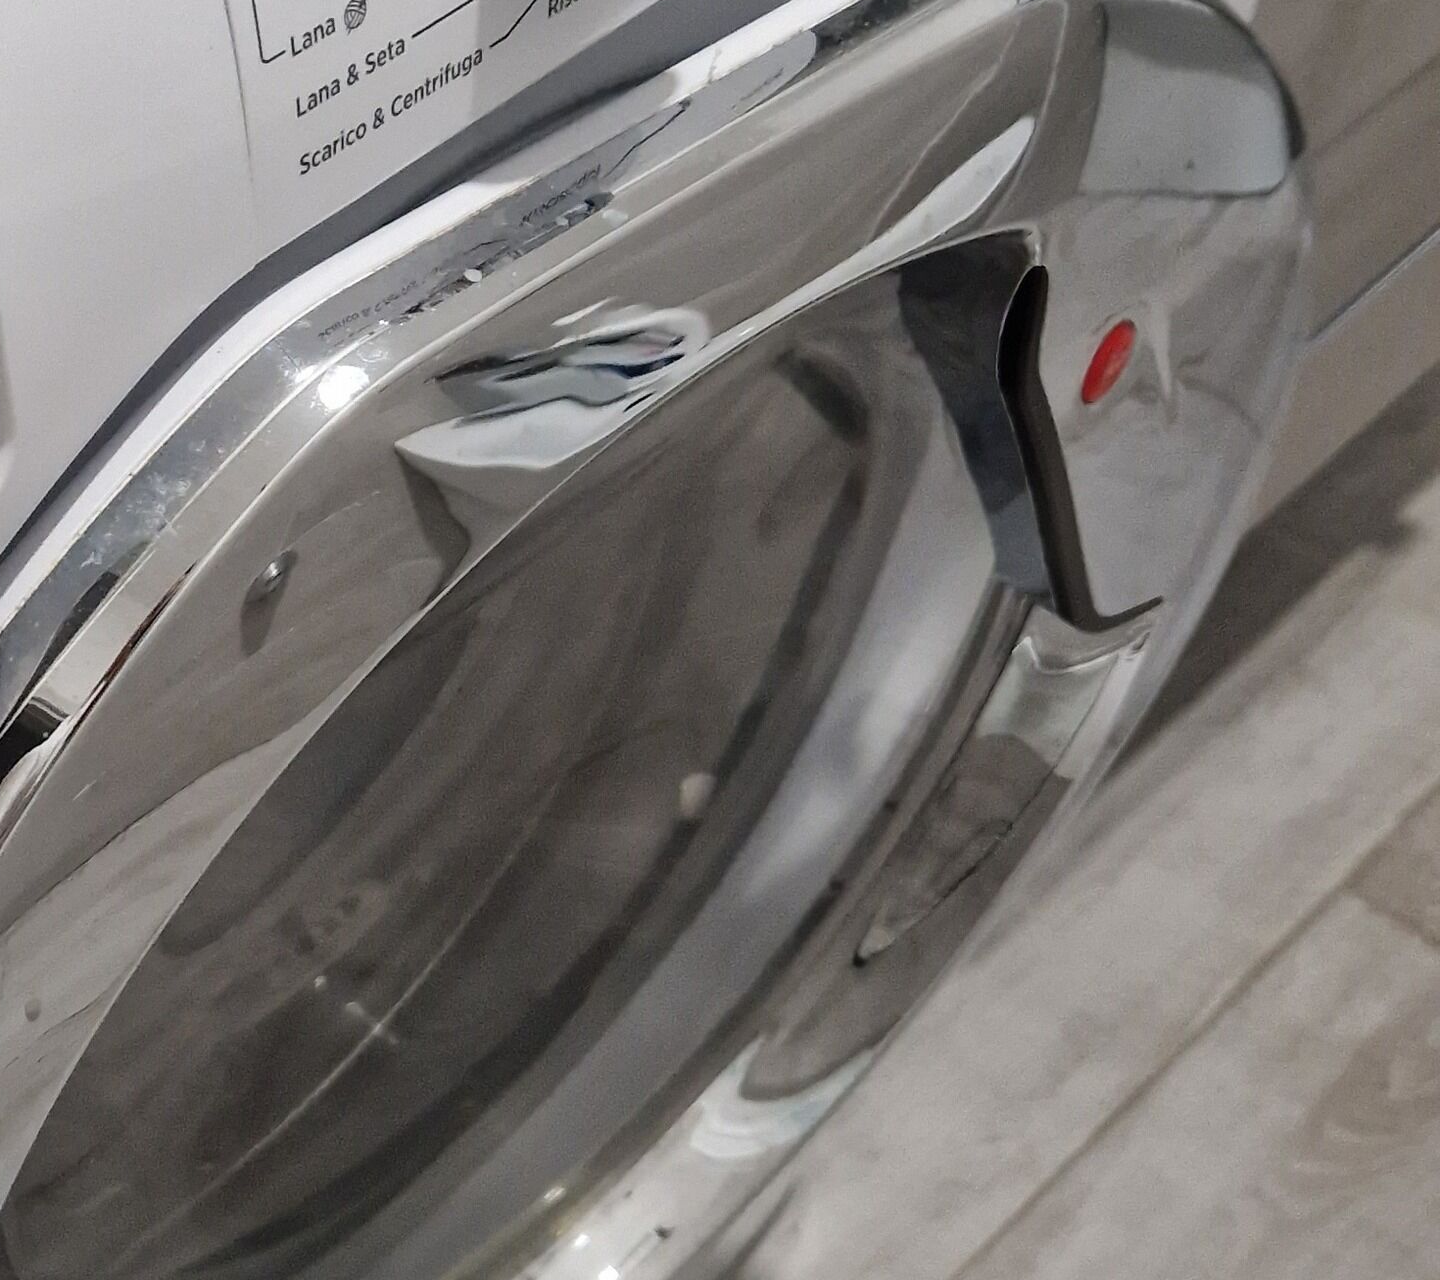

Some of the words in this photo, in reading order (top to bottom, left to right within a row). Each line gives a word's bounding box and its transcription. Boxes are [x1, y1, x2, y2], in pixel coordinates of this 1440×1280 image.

[290, 17, 336, 57] Lana
[296, 78, 341, 118] Lana
[346, 63, 360, 87] &
[365, 38, 406, 75] Seta
[299, 122, 367, 175] Scarico
[372, 107, 385, 130] &
[390, 48, 484, 117] Centrifuga
